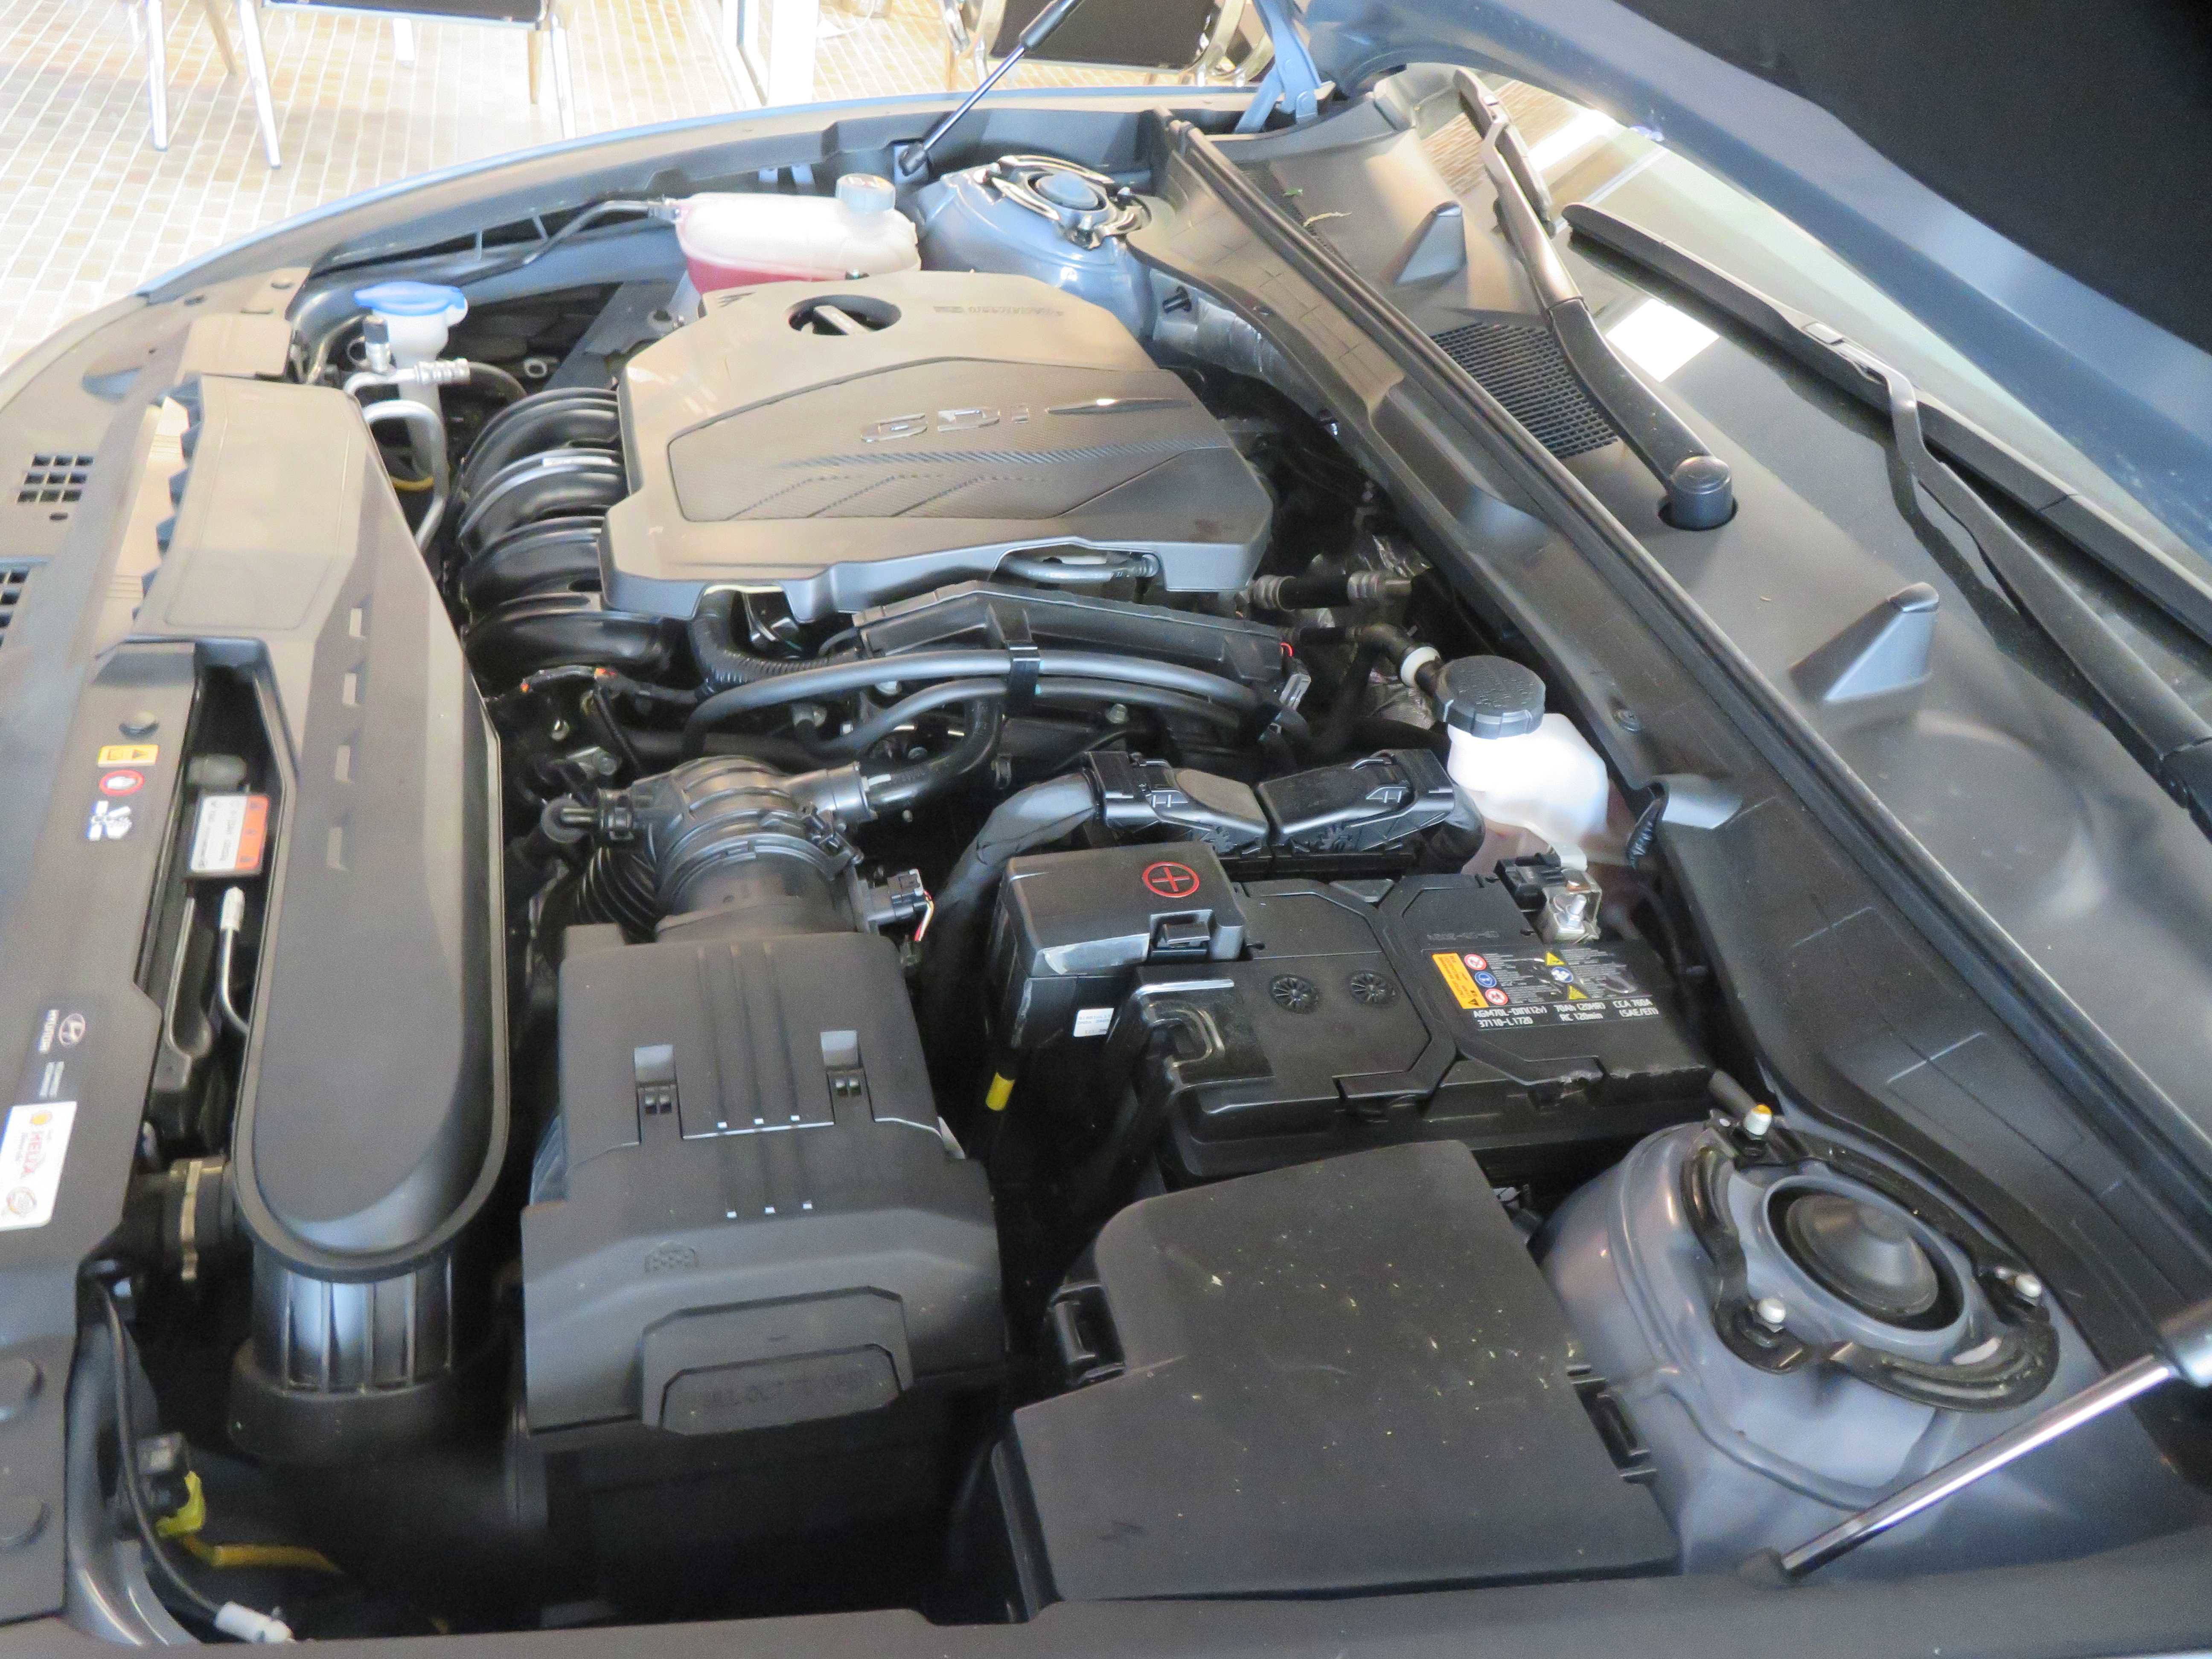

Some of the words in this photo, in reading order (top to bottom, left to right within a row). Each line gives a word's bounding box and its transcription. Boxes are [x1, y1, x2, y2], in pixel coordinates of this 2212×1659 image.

[1553, 1004, 1576, 1012] 70Ah
[1612, 1000, 1631, 1008] CCA
[1559, 1013, 1573, 1022] RC
